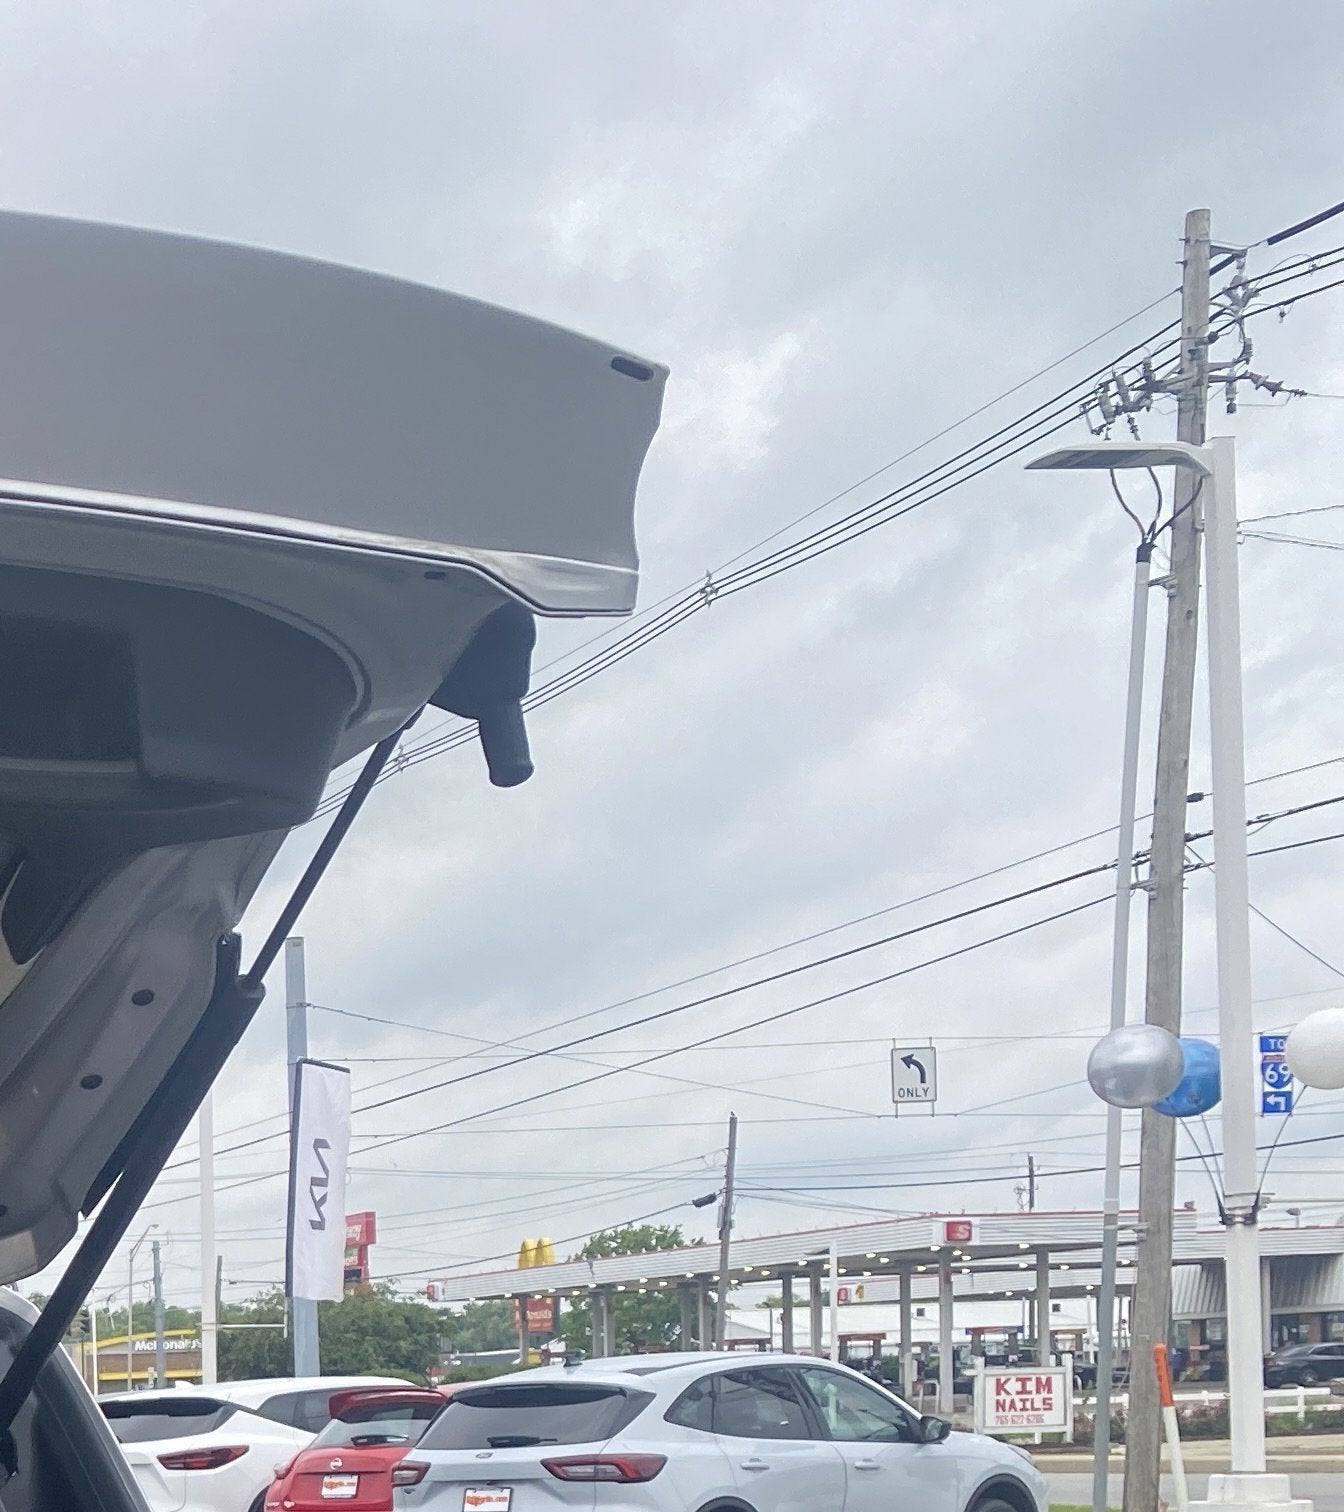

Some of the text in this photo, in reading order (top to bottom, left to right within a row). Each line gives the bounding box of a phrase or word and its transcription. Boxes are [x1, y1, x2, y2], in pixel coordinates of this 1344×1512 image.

[1269, 1038, 1285, 1050] TO
[1265, 1062, 1291, 1083] 69
[898, 1087, 930, 1098] ONLY
[995, 1376, 1053, 1396] KIM
[995, 1397, 1053, 1412] NAILS
